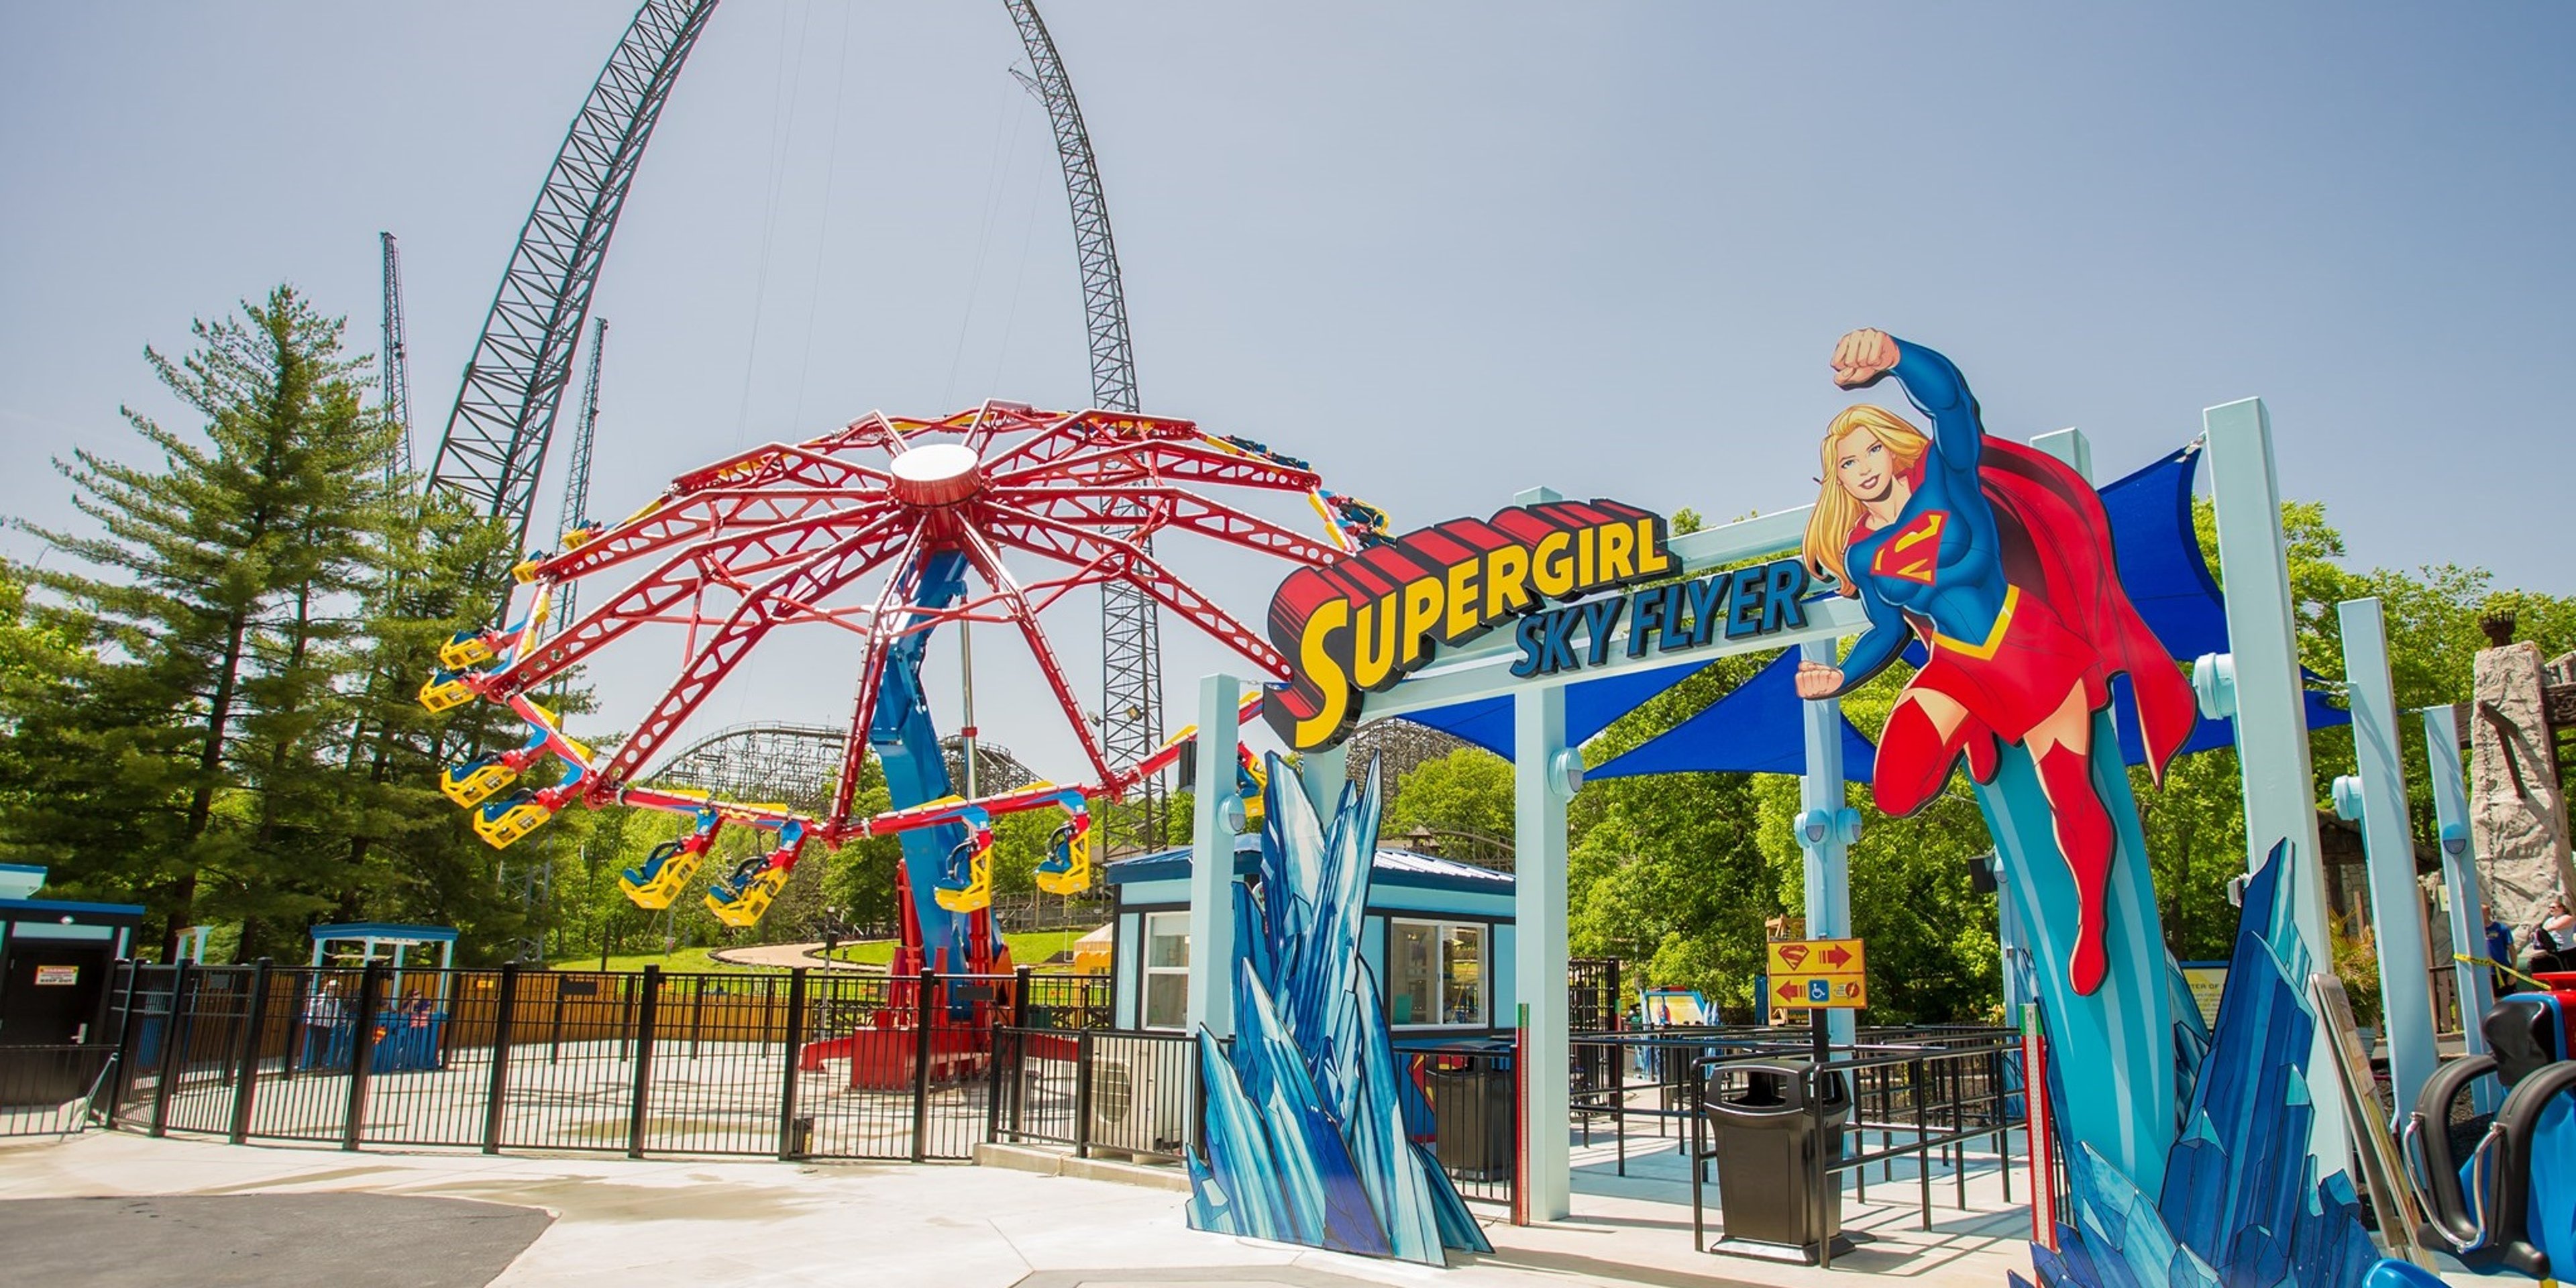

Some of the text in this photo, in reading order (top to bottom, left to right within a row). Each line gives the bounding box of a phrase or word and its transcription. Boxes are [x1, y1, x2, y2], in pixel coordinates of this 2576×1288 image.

[1294, 519, 1668, 749] SUPERGIRL
[1510, 559, 1809, 678] SKY FLYER
